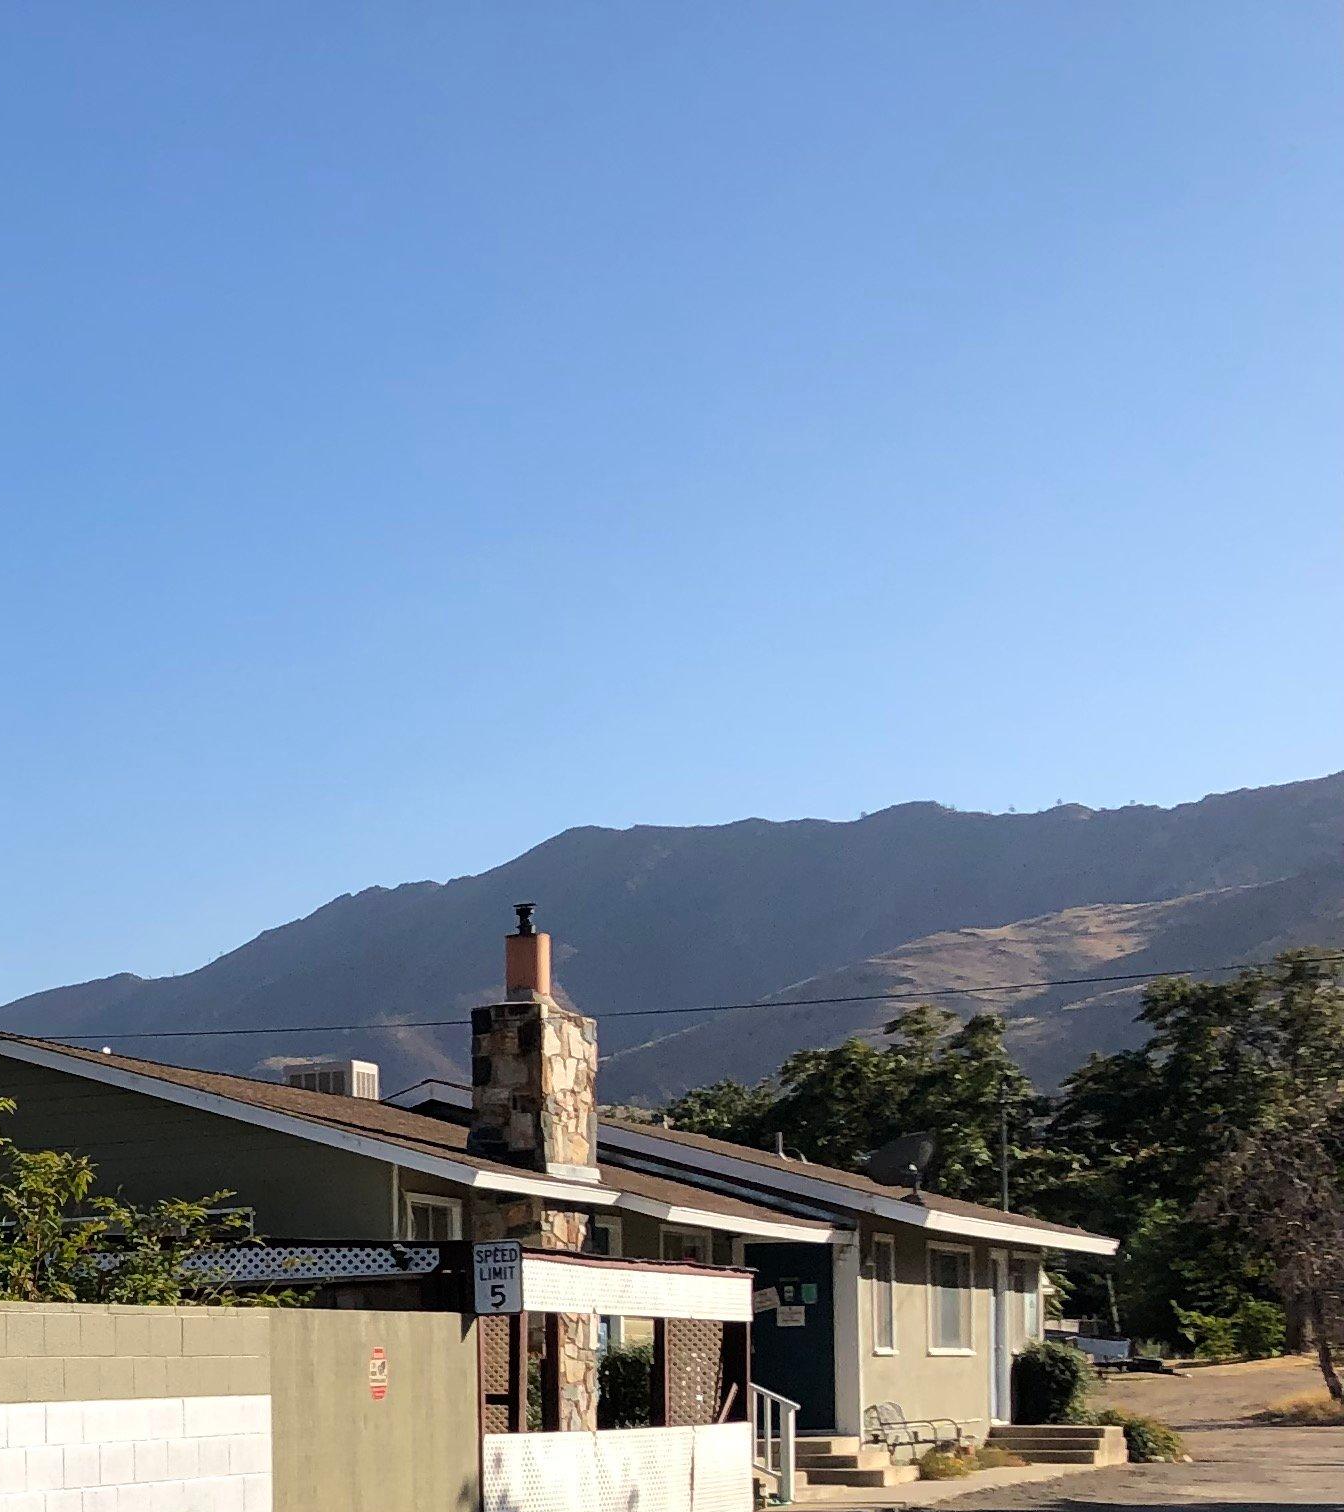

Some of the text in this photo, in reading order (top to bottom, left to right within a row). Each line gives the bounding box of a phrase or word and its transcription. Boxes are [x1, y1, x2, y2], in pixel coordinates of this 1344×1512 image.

[476, 1247, 518, 1263] SPEED
[479, 1266, 515, 1281] LIMIT
[490, 1284, 506, 1308] 5
